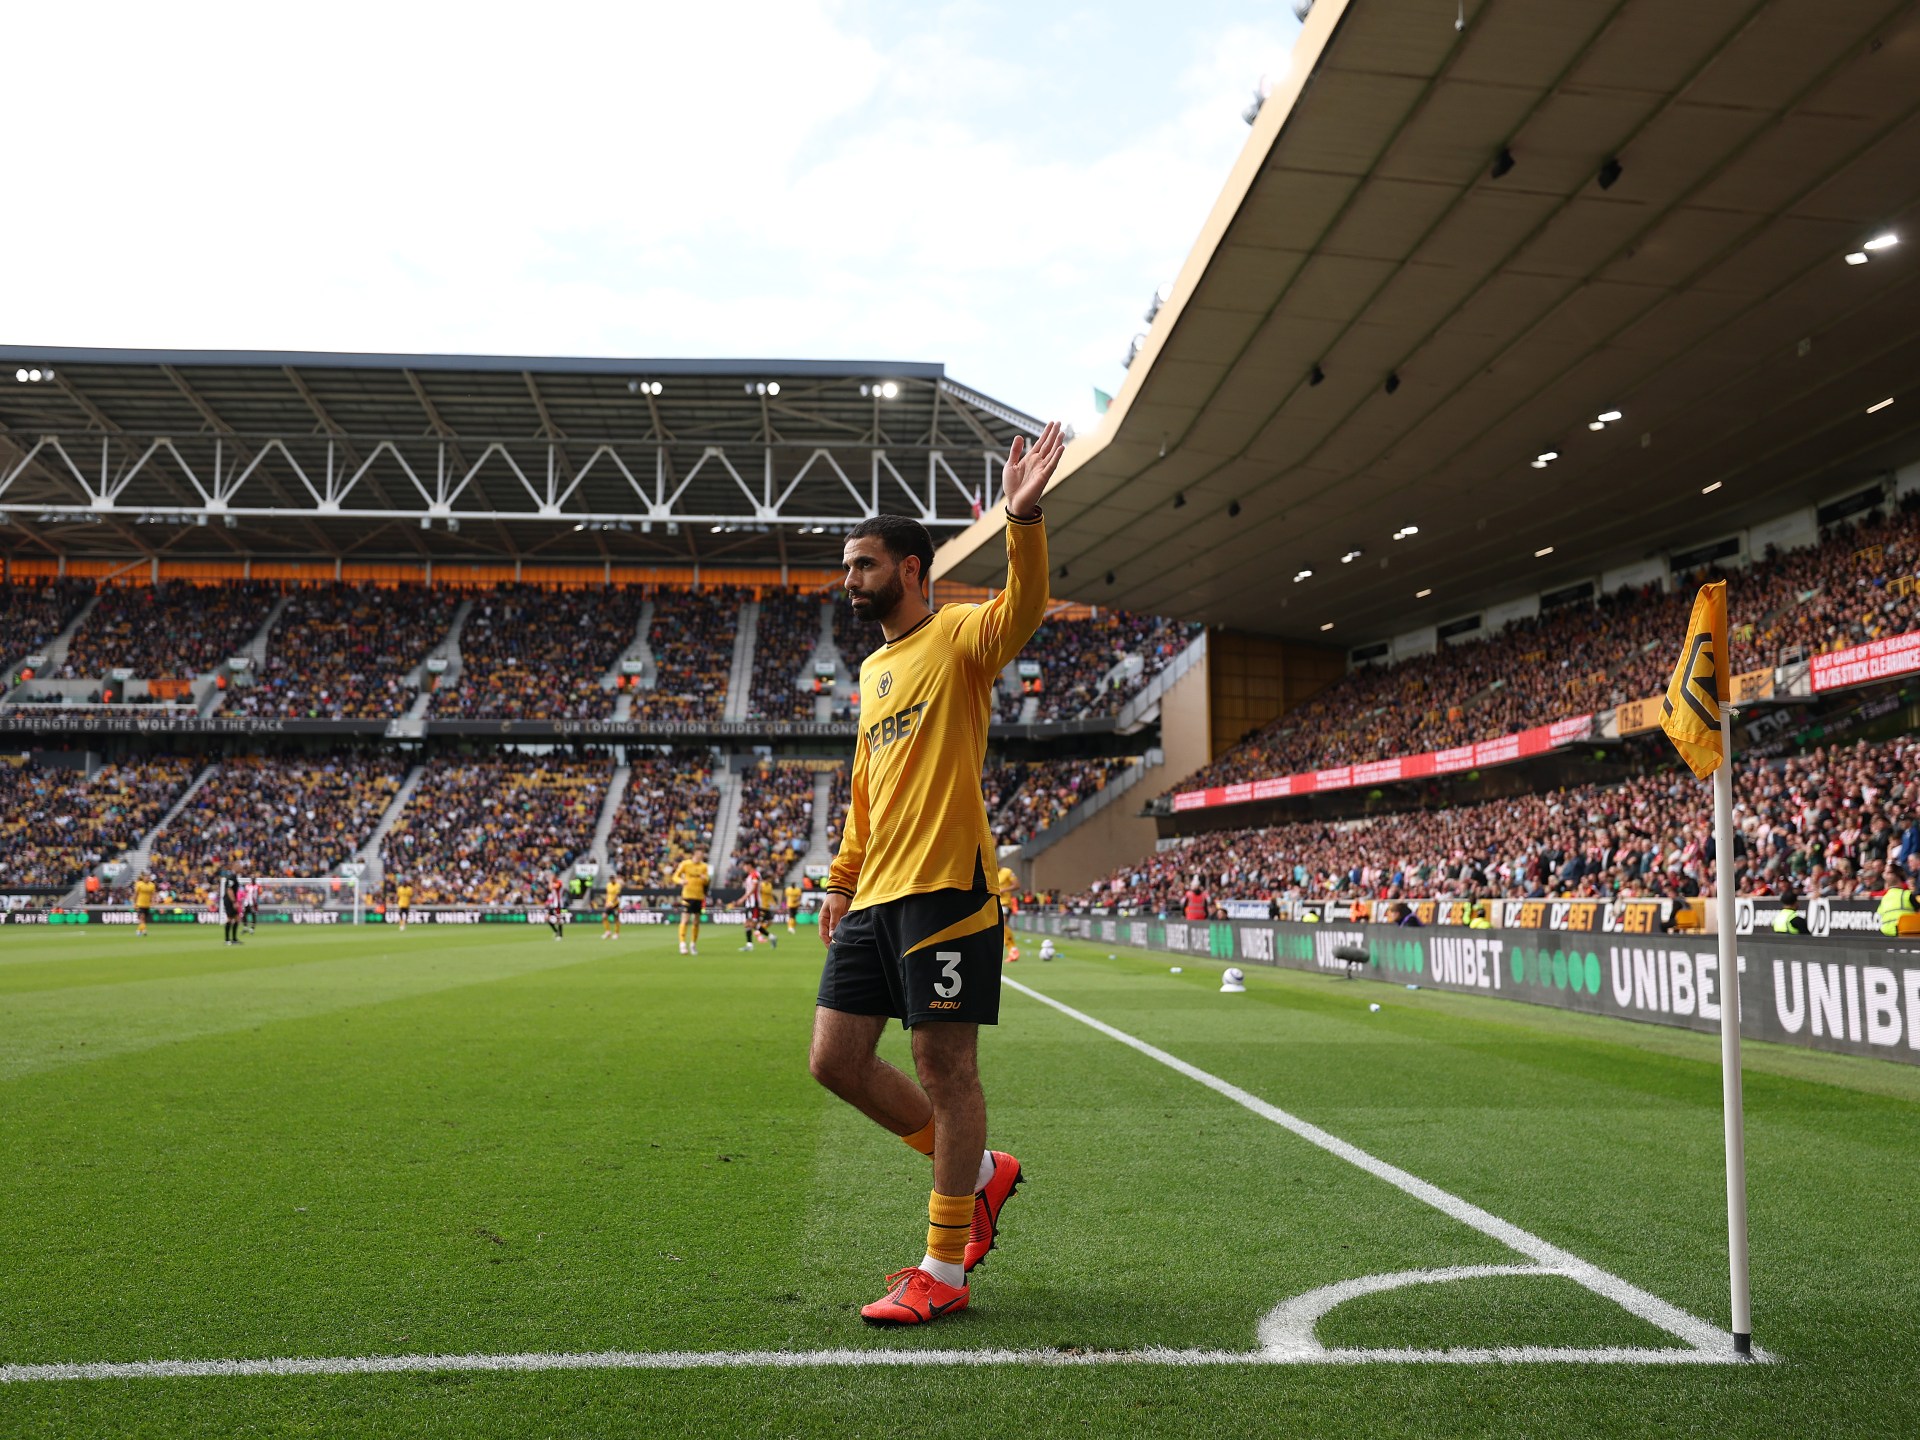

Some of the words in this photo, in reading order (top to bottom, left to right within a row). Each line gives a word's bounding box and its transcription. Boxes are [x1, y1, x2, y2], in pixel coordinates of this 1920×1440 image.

[1833, 648, 1856, 666] GAME
[1857, 646, 1867, 660] OF
[9, 719, 78, 730] STRENGTH
[84, 719, 100, 730] OF
[107, 719, 131, 730] THE
[138, 719, 176, 731] WOLF
[182, 719, 195, 731] IS
[201, 719, 215, 731] IN
[222, 719, 245, 731] THE
[252, 719, 284, 731] PACK
[554, 722, 580, 734] OUR
[585, 722, 635, 734] LOVING
[640, 722, 707, 734] DEVOTION
[711, 722, 761, 735] GUIDES
[765, 722, 791, 735] OUR
[292, 911, 338, 924] UNIBET
[436, 911, 481, 924] UNIBET
[618, 911, 664, 924] UNIBET
[1430, 937, 1503, 990] UNIBET
[934, 952, 962, 998] 3
[928, 1001, 961, 1009] SUDU
